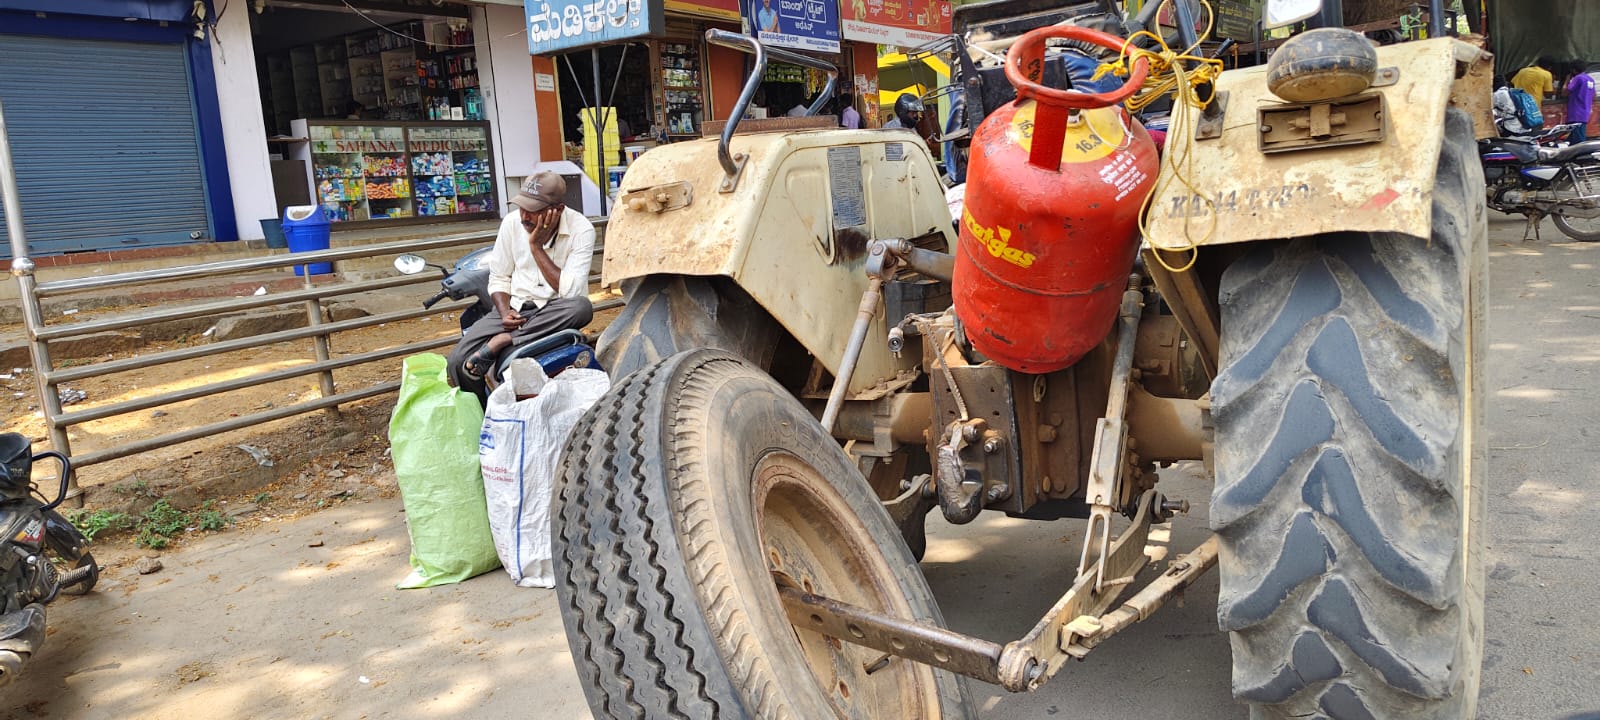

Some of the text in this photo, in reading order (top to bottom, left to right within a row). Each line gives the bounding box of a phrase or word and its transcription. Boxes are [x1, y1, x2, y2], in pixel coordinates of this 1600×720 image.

[335, 140, 476, 152] SAHANA MEDICALS
[1076, 133, 1102, 153] 16.3
